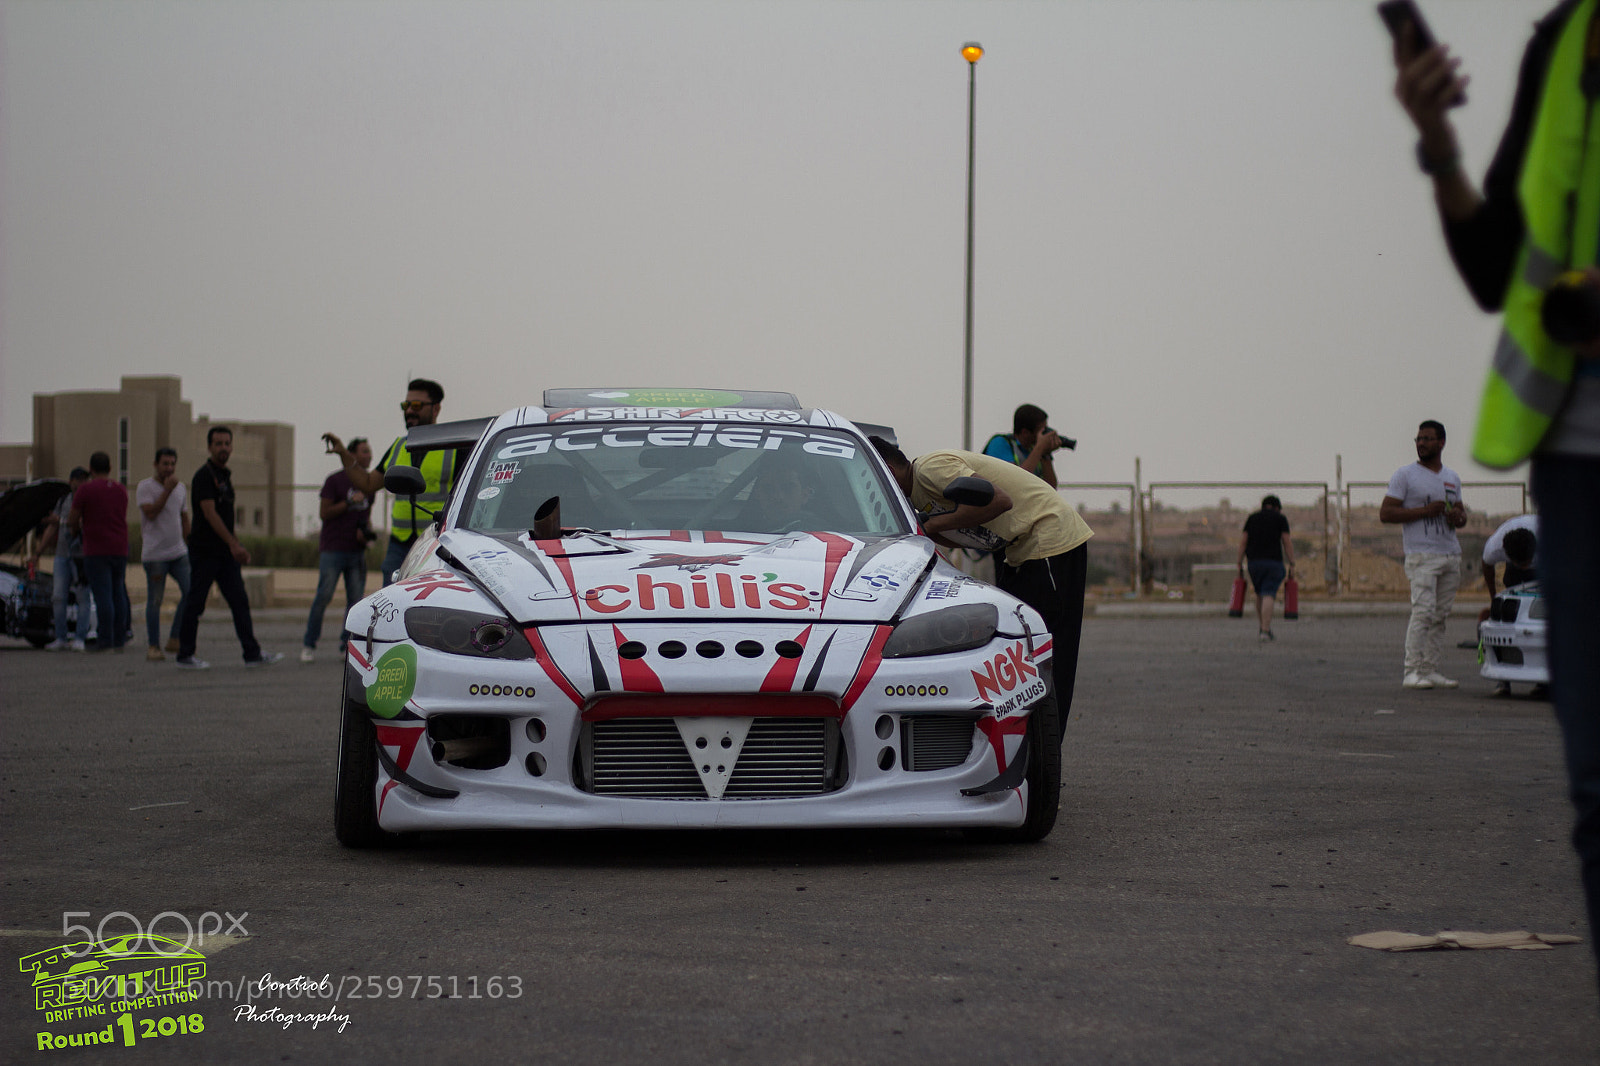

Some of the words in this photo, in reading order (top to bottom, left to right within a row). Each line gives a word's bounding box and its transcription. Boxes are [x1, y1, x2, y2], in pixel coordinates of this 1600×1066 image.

[497, 423, 856, 460] accelera
[378, 667, 406, 682] GREEN
[970, 640, 1037, 703] NGK
[373, 685, 403, 700] APPLE
[995, 697, 1017, 718] SPARK
[1015, 681, 1045, 706] PLUGS
